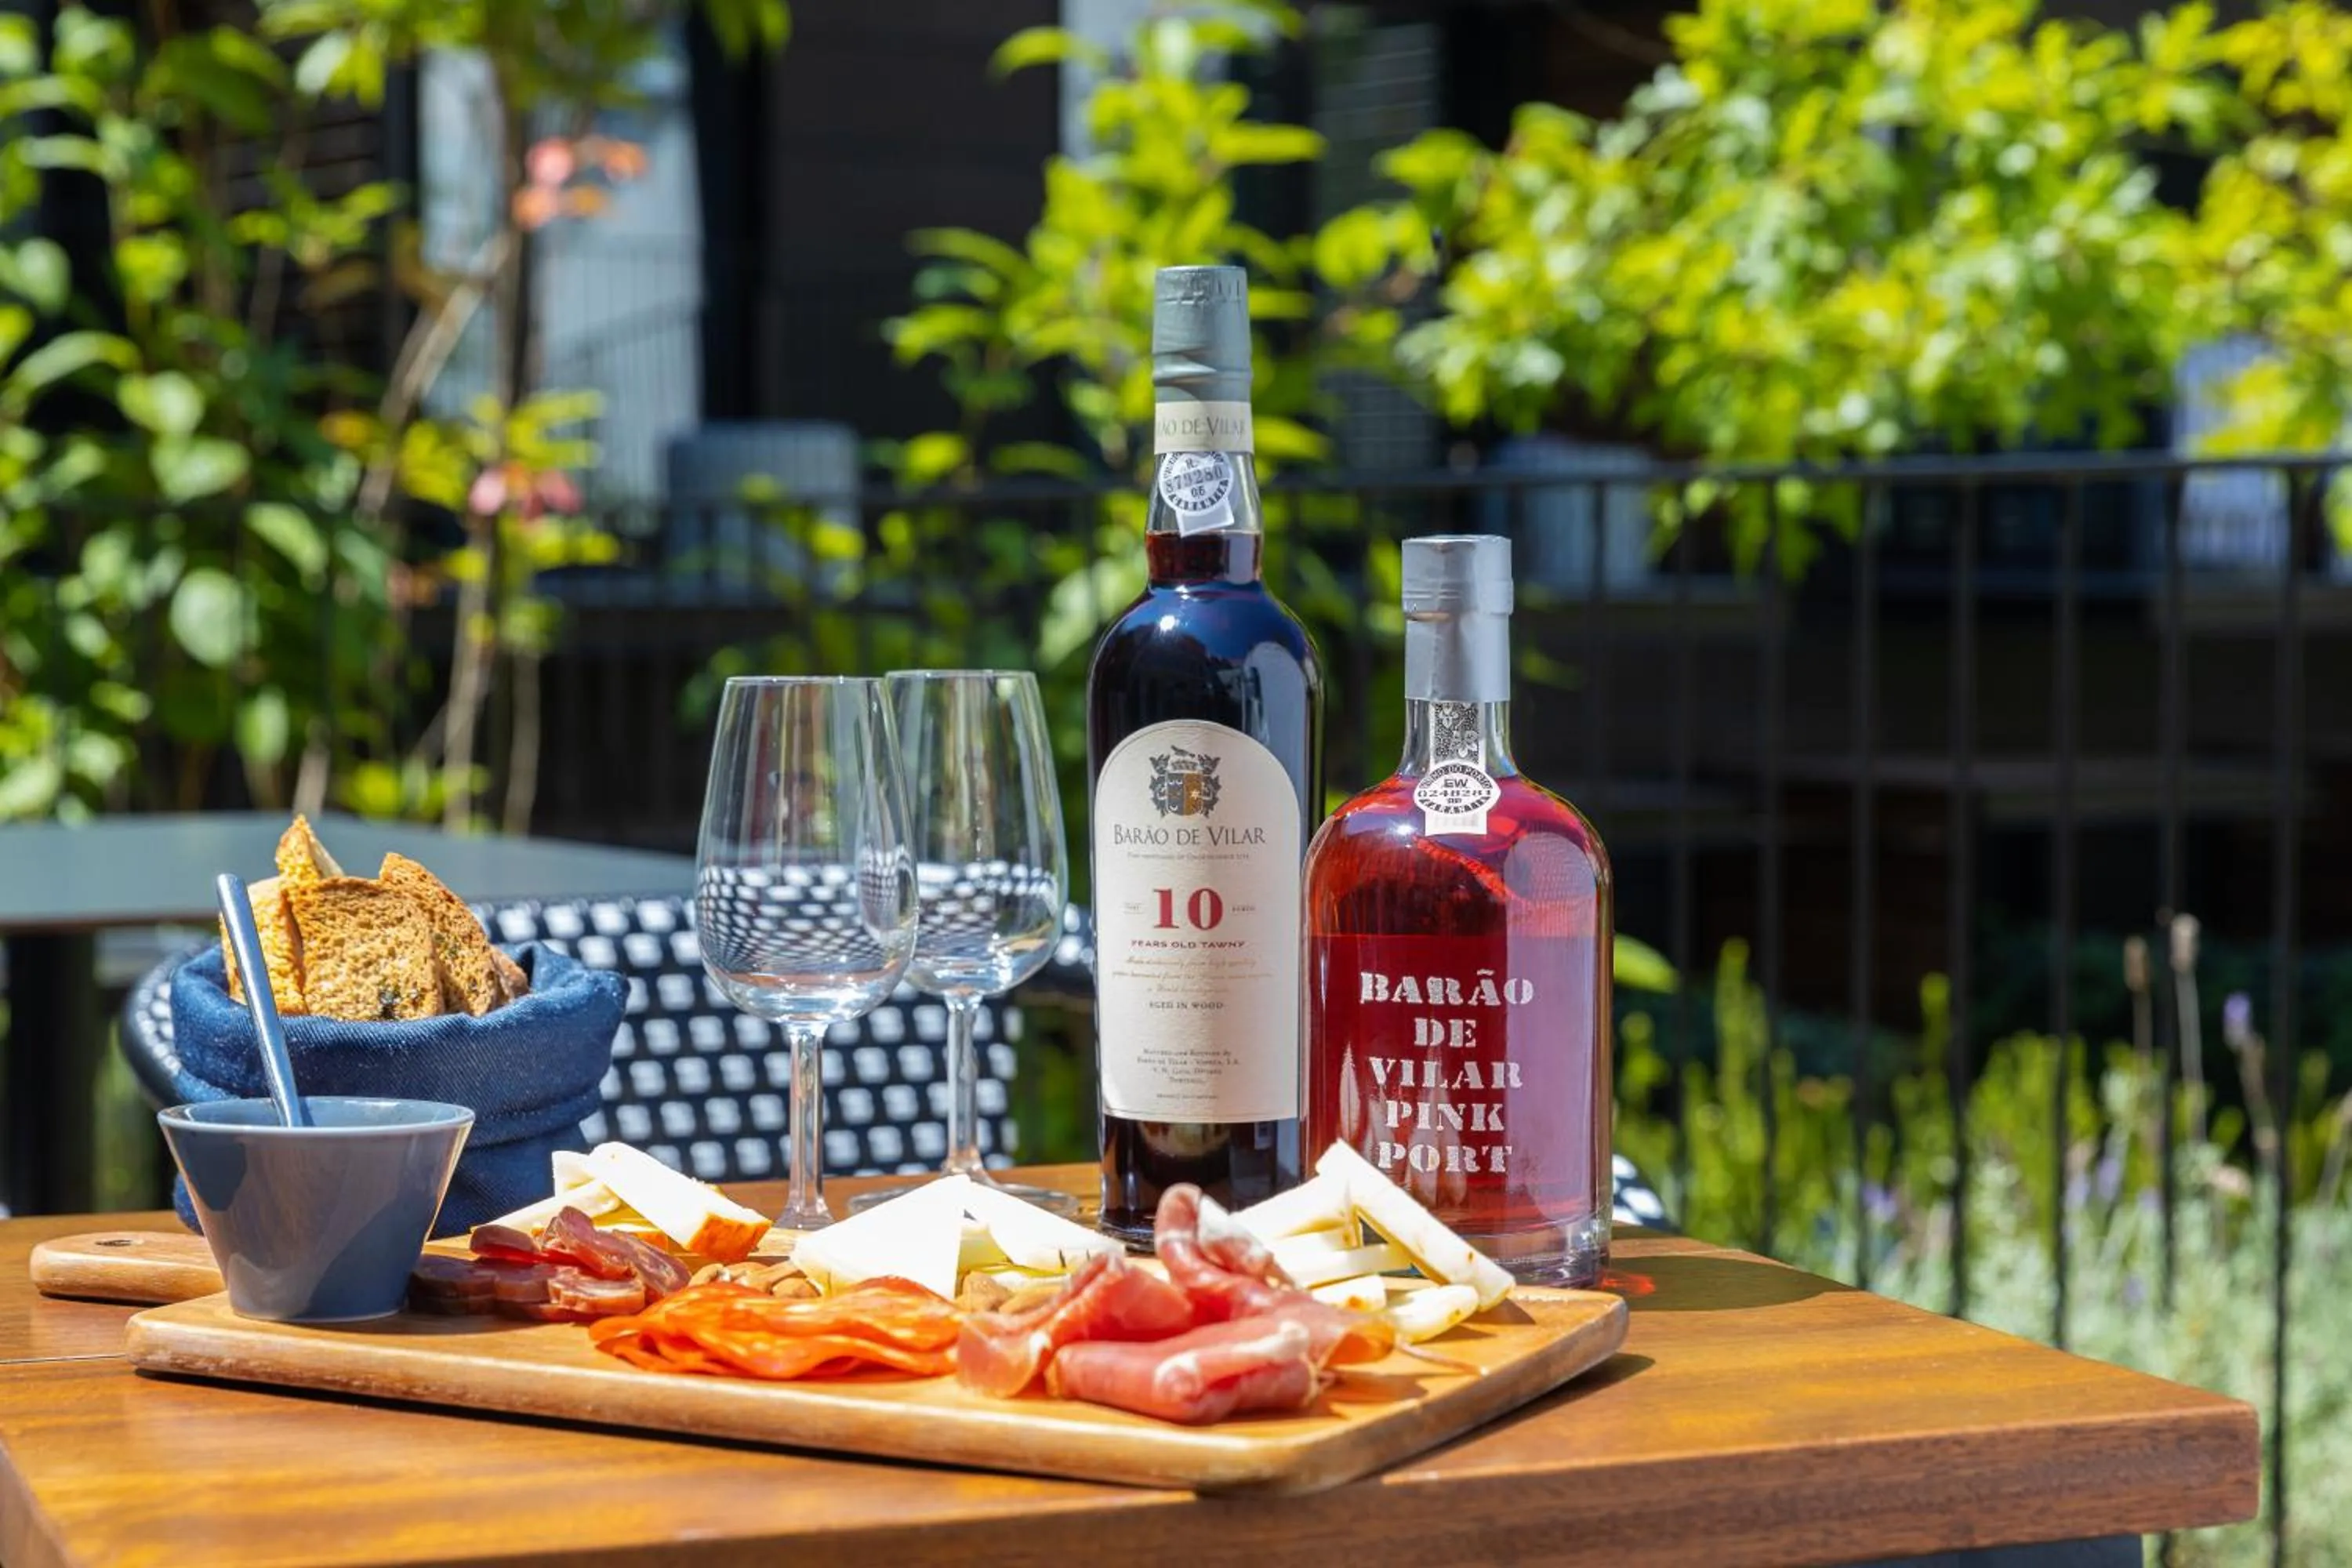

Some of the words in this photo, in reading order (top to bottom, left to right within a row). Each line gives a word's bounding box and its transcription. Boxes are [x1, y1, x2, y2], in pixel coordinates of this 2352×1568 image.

[1114, 823, 1168, 845] BARÃO
[1177, 828, 1200, 845] DE
[1207, 826, 1266, 845] VILAR
[1152, 887, 1223, 931] 10
[1131, 940, 1167, 949] YEARS
[1359, 968, 1534, 1006] BARÃO
[1414, 1018, 1477, 1047] DE
[1369, 1057, 1523, 1089] VILAR
[1385, 1100, 1504, 1131] PINK
[1377, 1141, 1512, 1173] PORT
